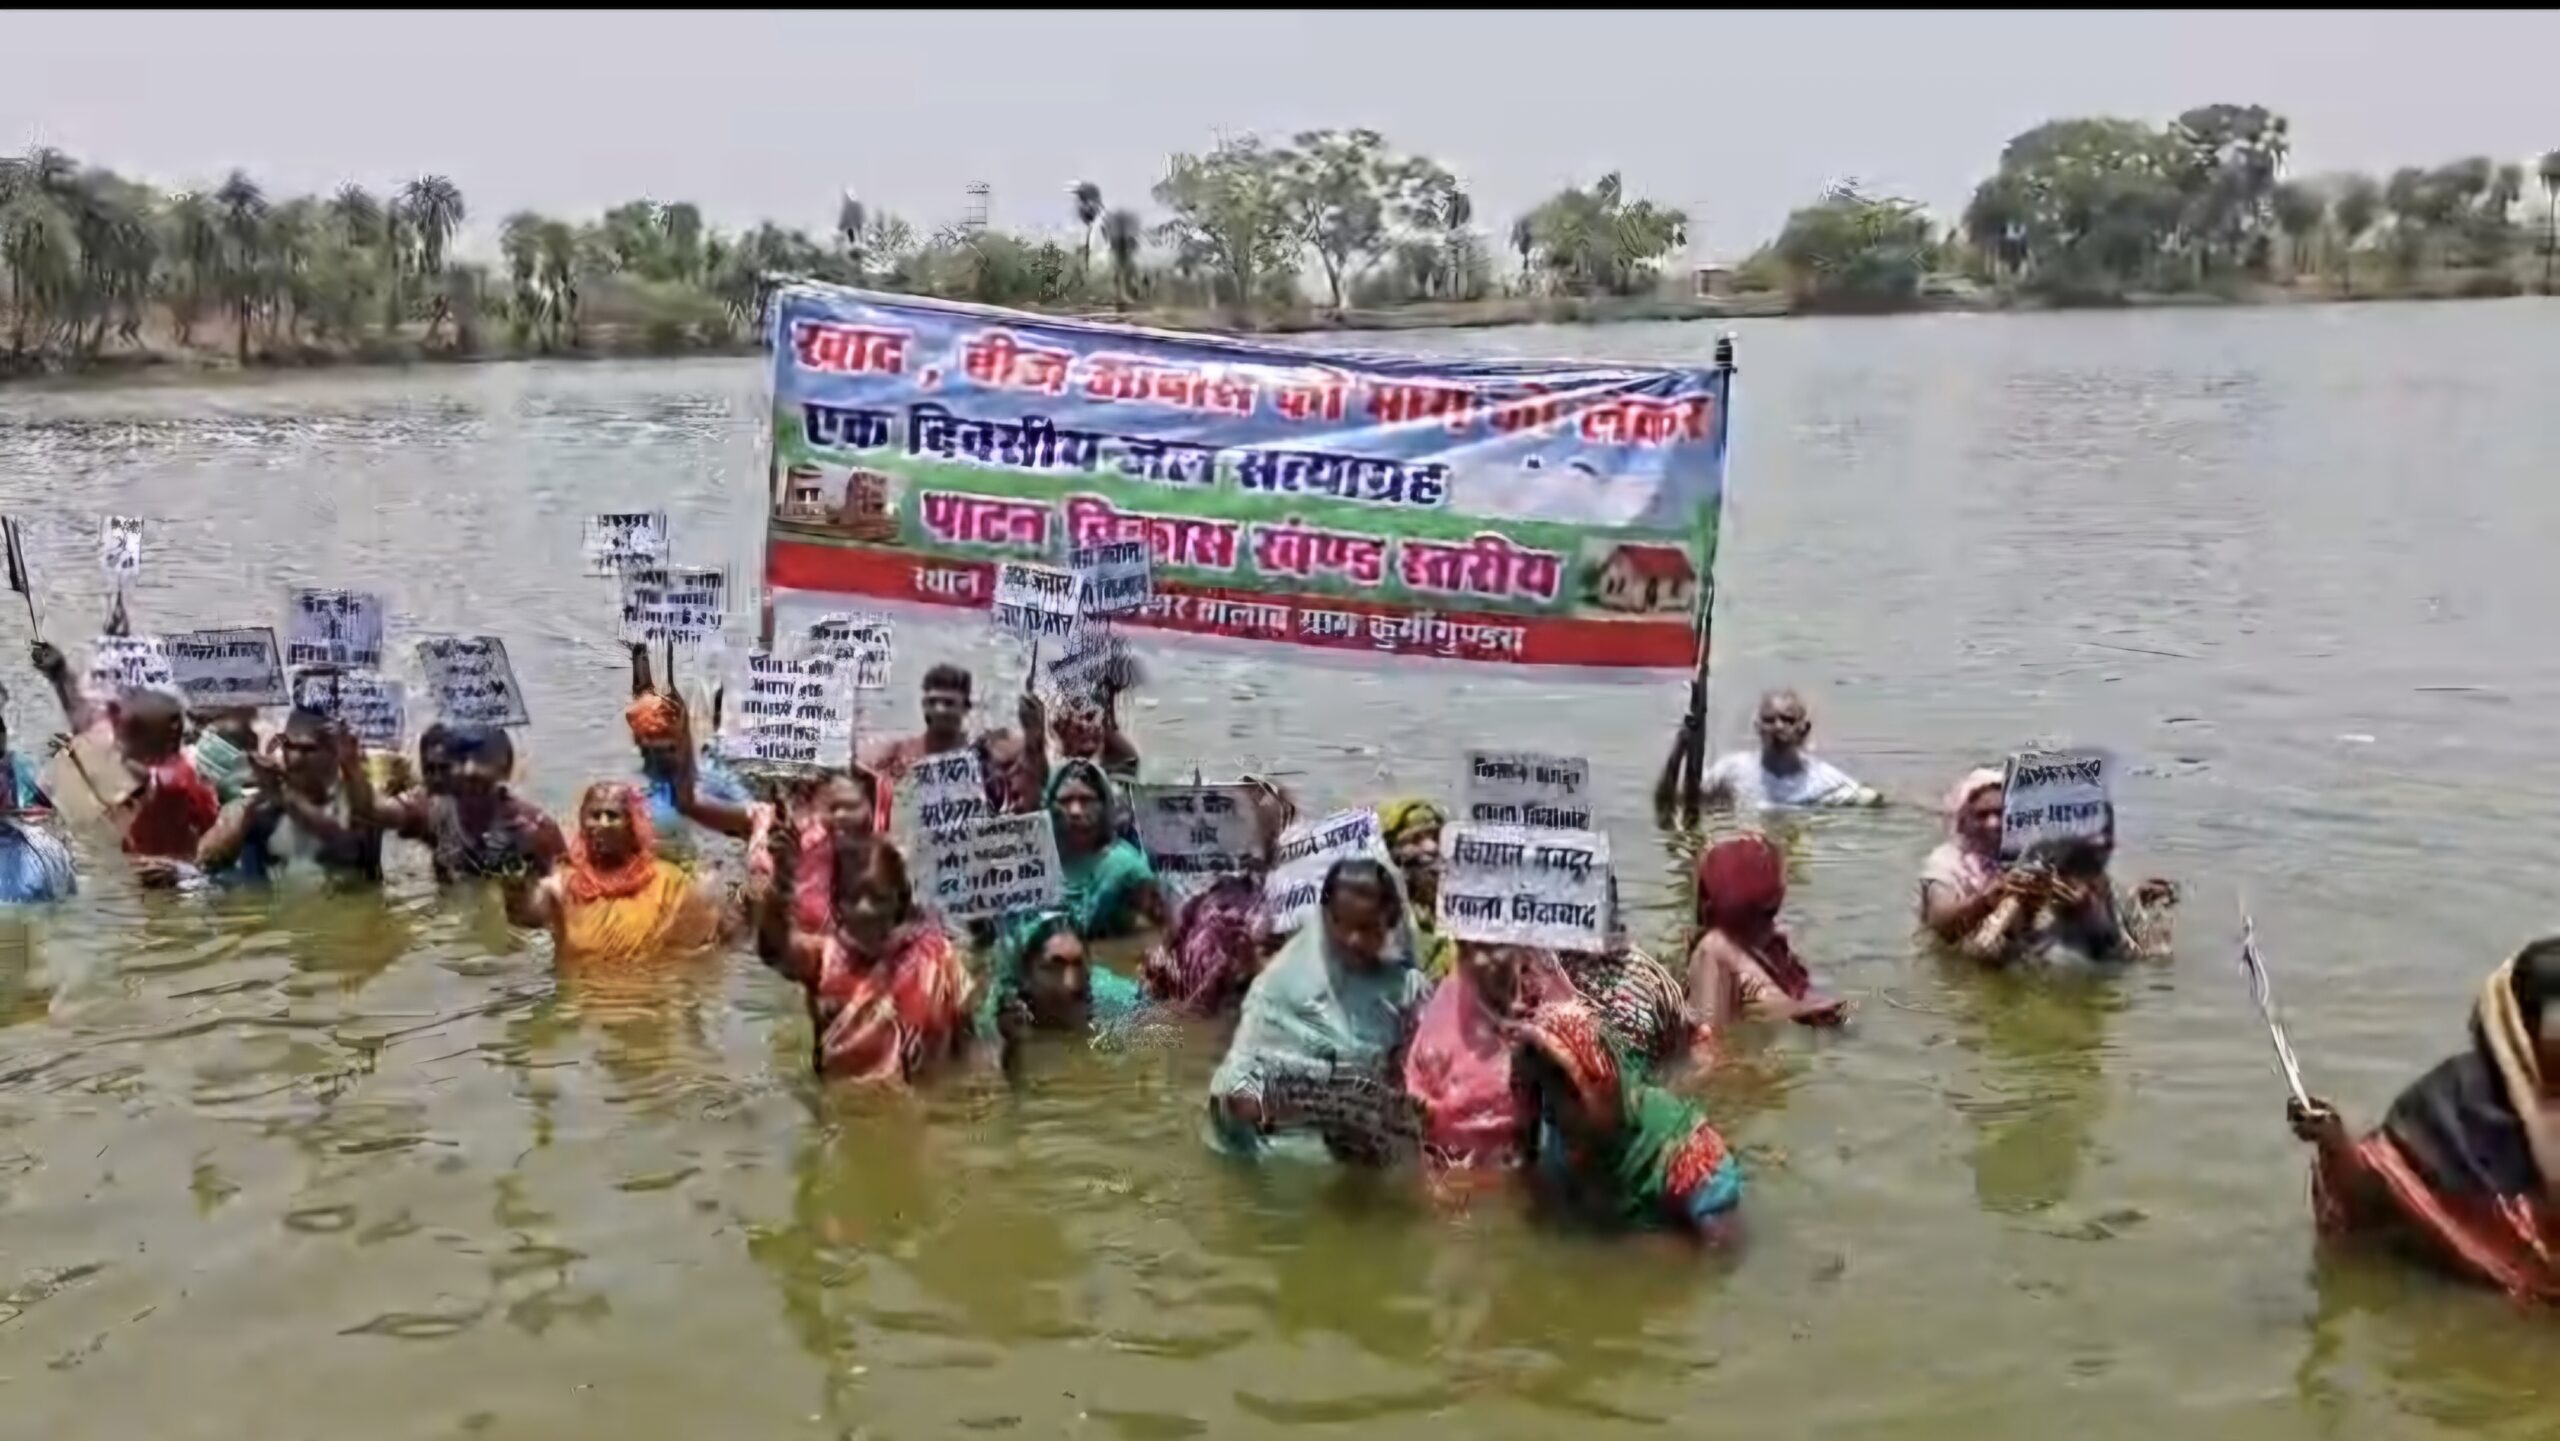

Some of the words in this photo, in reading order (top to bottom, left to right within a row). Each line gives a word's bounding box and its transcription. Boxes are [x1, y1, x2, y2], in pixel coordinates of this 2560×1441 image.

[803, 402, 893, 451] एक
[908, 400, 1100, 472] दिवसीय
[1236, 447, 1452, 504] सत्याग्रह
[922, 490, 1050, 545] पाटन
[914, 564, 981, 597] स्थान
[1197, 597, 1293, 632] तालाब
[1299, 608, 1359, 638] ग्राम
[1454, 833, 1525, 868] किसान
